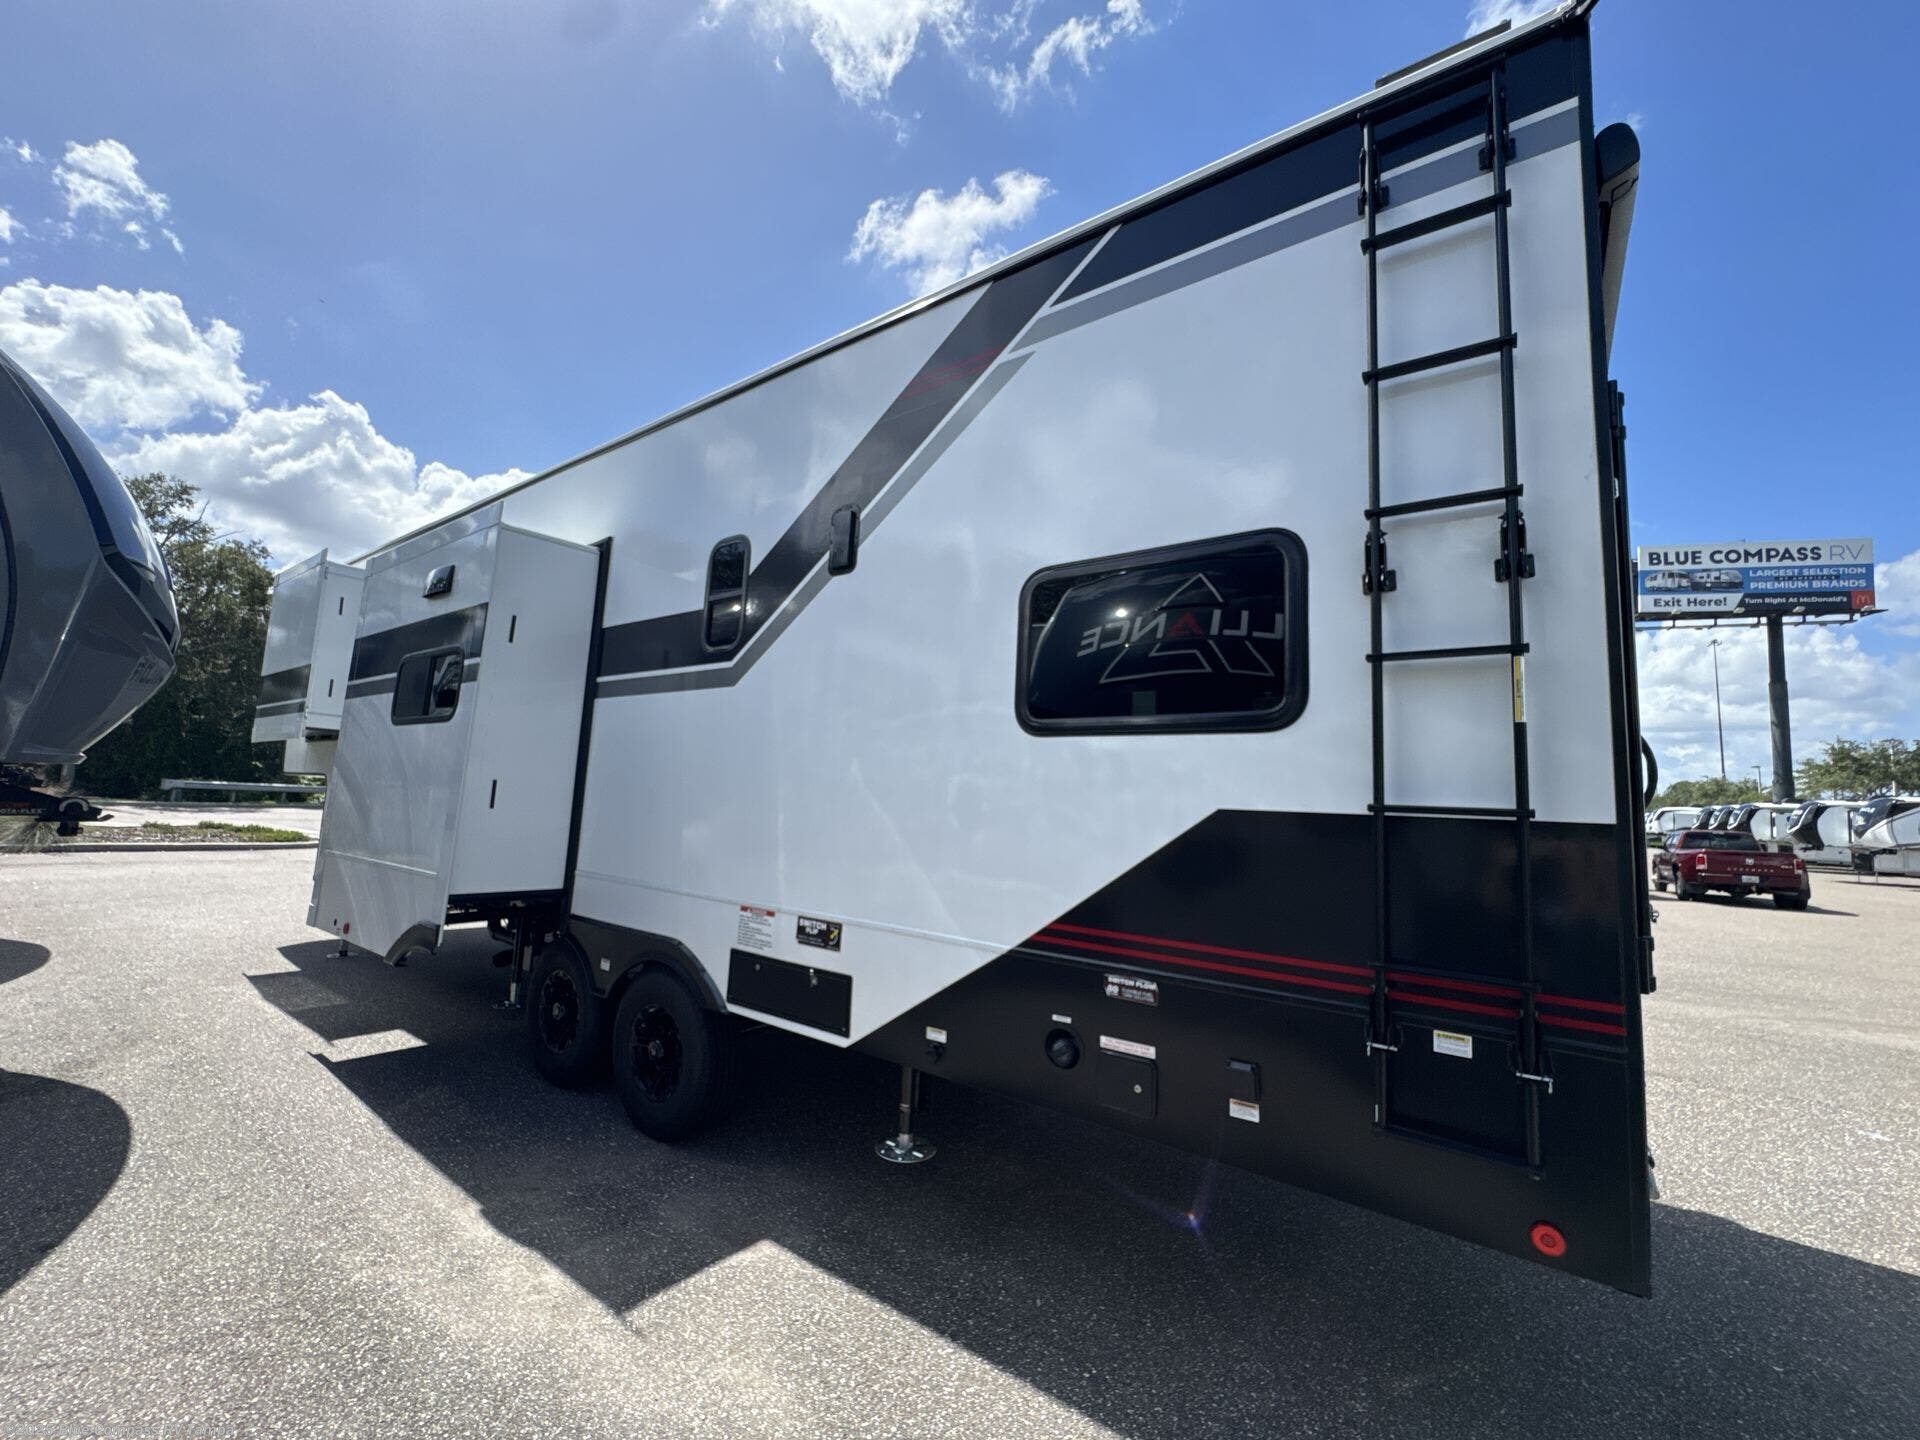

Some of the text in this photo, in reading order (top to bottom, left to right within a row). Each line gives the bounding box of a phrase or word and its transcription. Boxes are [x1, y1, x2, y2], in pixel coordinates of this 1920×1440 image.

[1648, 544, 1865, 566] BLUE COMPASS RV
[1749, 567, 1866, 577] LARGEST SELECTION
[1750, 580, 1867, 589] PREMIUM BRANDS
[1653, 597, 1727, 607] Exit Here!
